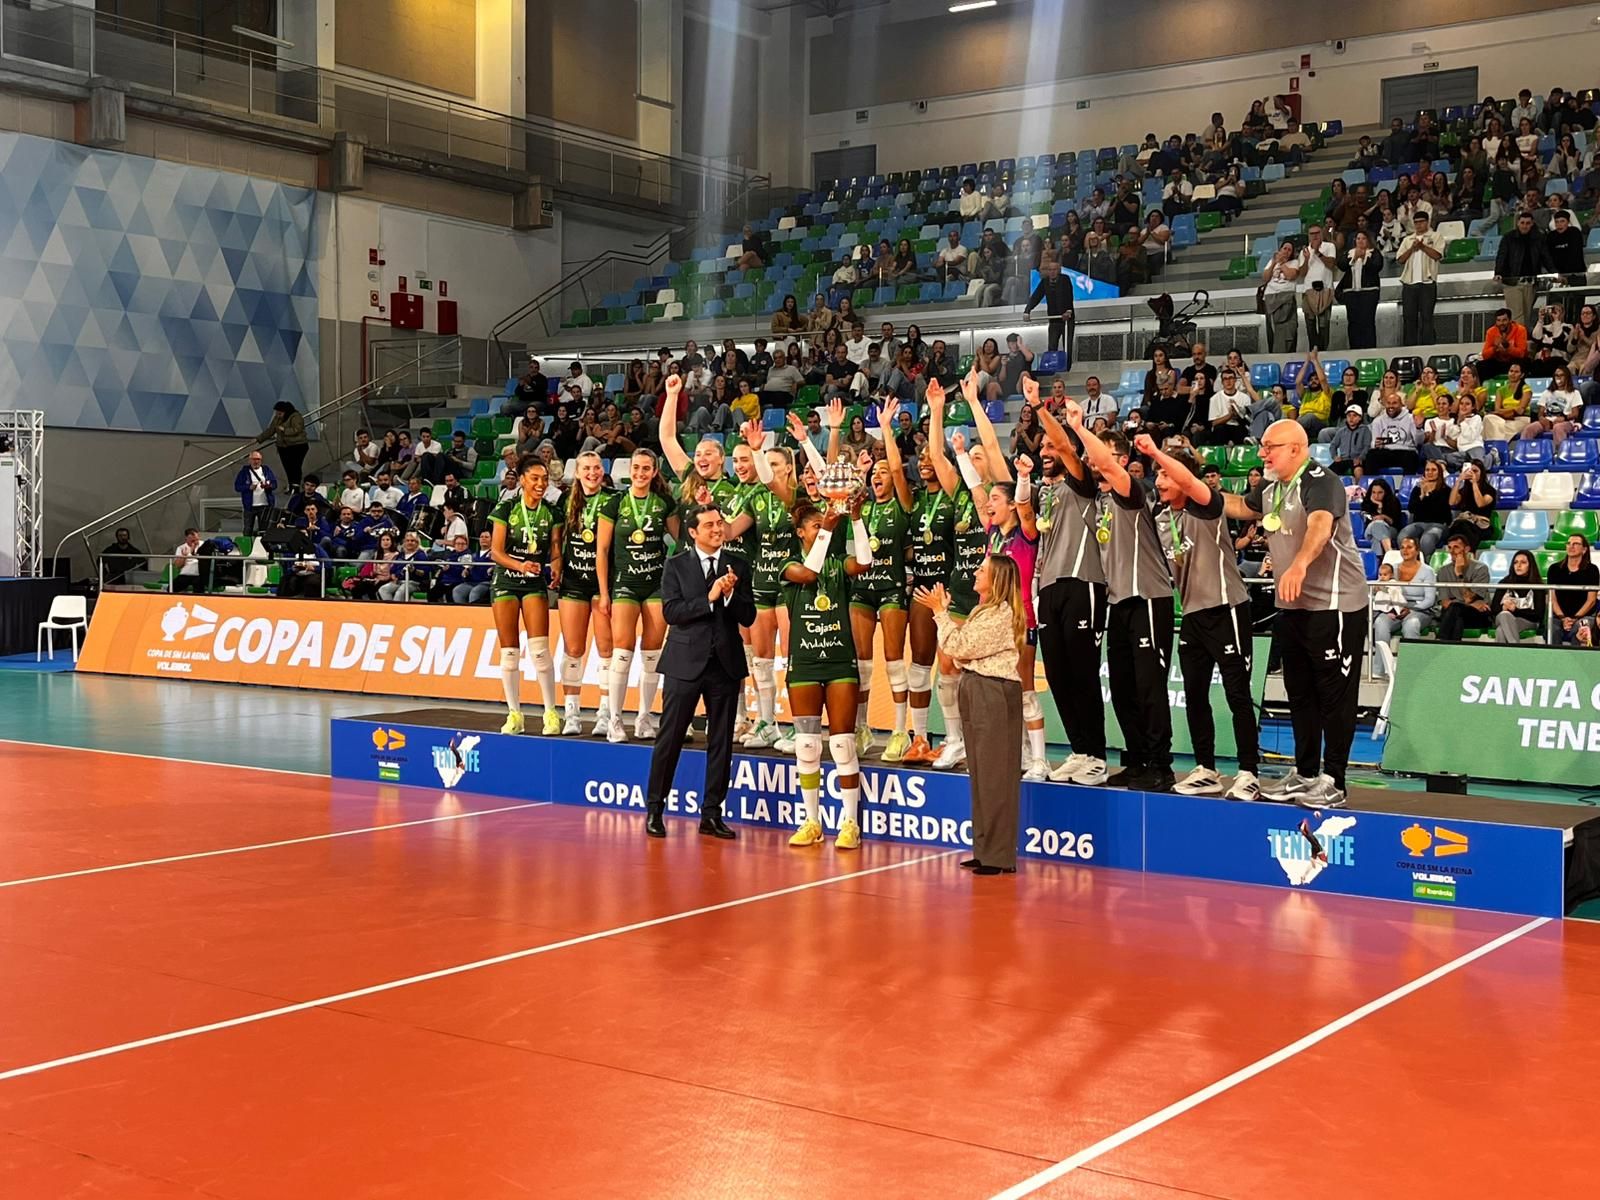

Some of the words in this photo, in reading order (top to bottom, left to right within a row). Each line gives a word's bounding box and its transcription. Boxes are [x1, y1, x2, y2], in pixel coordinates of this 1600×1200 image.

[871, 555, 893, 568] jasol
[805, 620, 841, 635] Cajasol
[213, 616, 323, 667] COPA
[329, 622, 395, 672] DE
[392, 625, 473, 677] SM
[1460, 675, 1581, 710] SANTA
[729, 760, 926, 808] AMPONAS
[585, 780, 646, 808] COPA
[664, 788, 679, 811] E
[740, 796, 771, 822] LA
[1025, 827, 1094, 860] 2026
[1396, 861, 1416, 869] COPA
[1426, 863, 1439, 871] SM
[1440, 865, 1449, 873] LA
